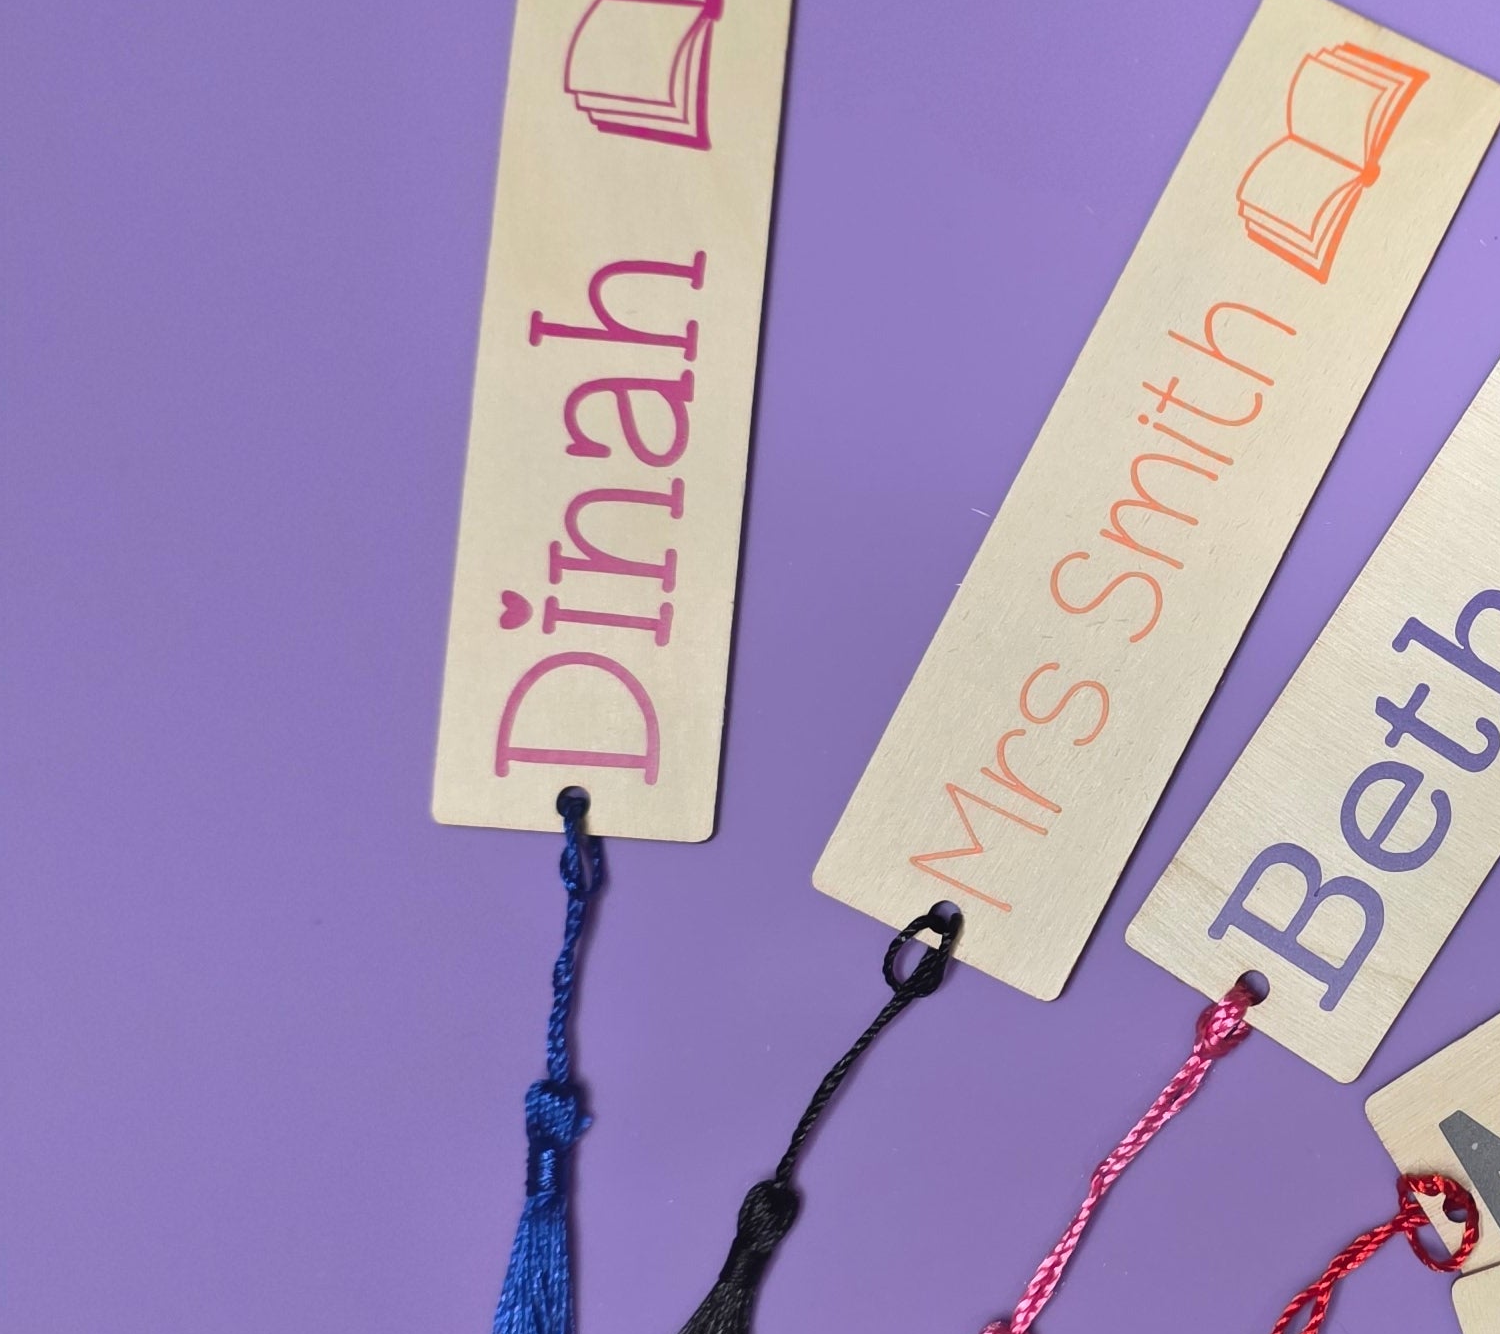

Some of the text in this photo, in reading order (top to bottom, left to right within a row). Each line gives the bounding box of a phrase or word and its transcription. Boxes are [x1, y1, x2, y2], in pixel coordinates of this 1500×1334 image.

[495, 250, 707, 785] Dinah
[908, 299, 1297, 912] Mrs Smith
